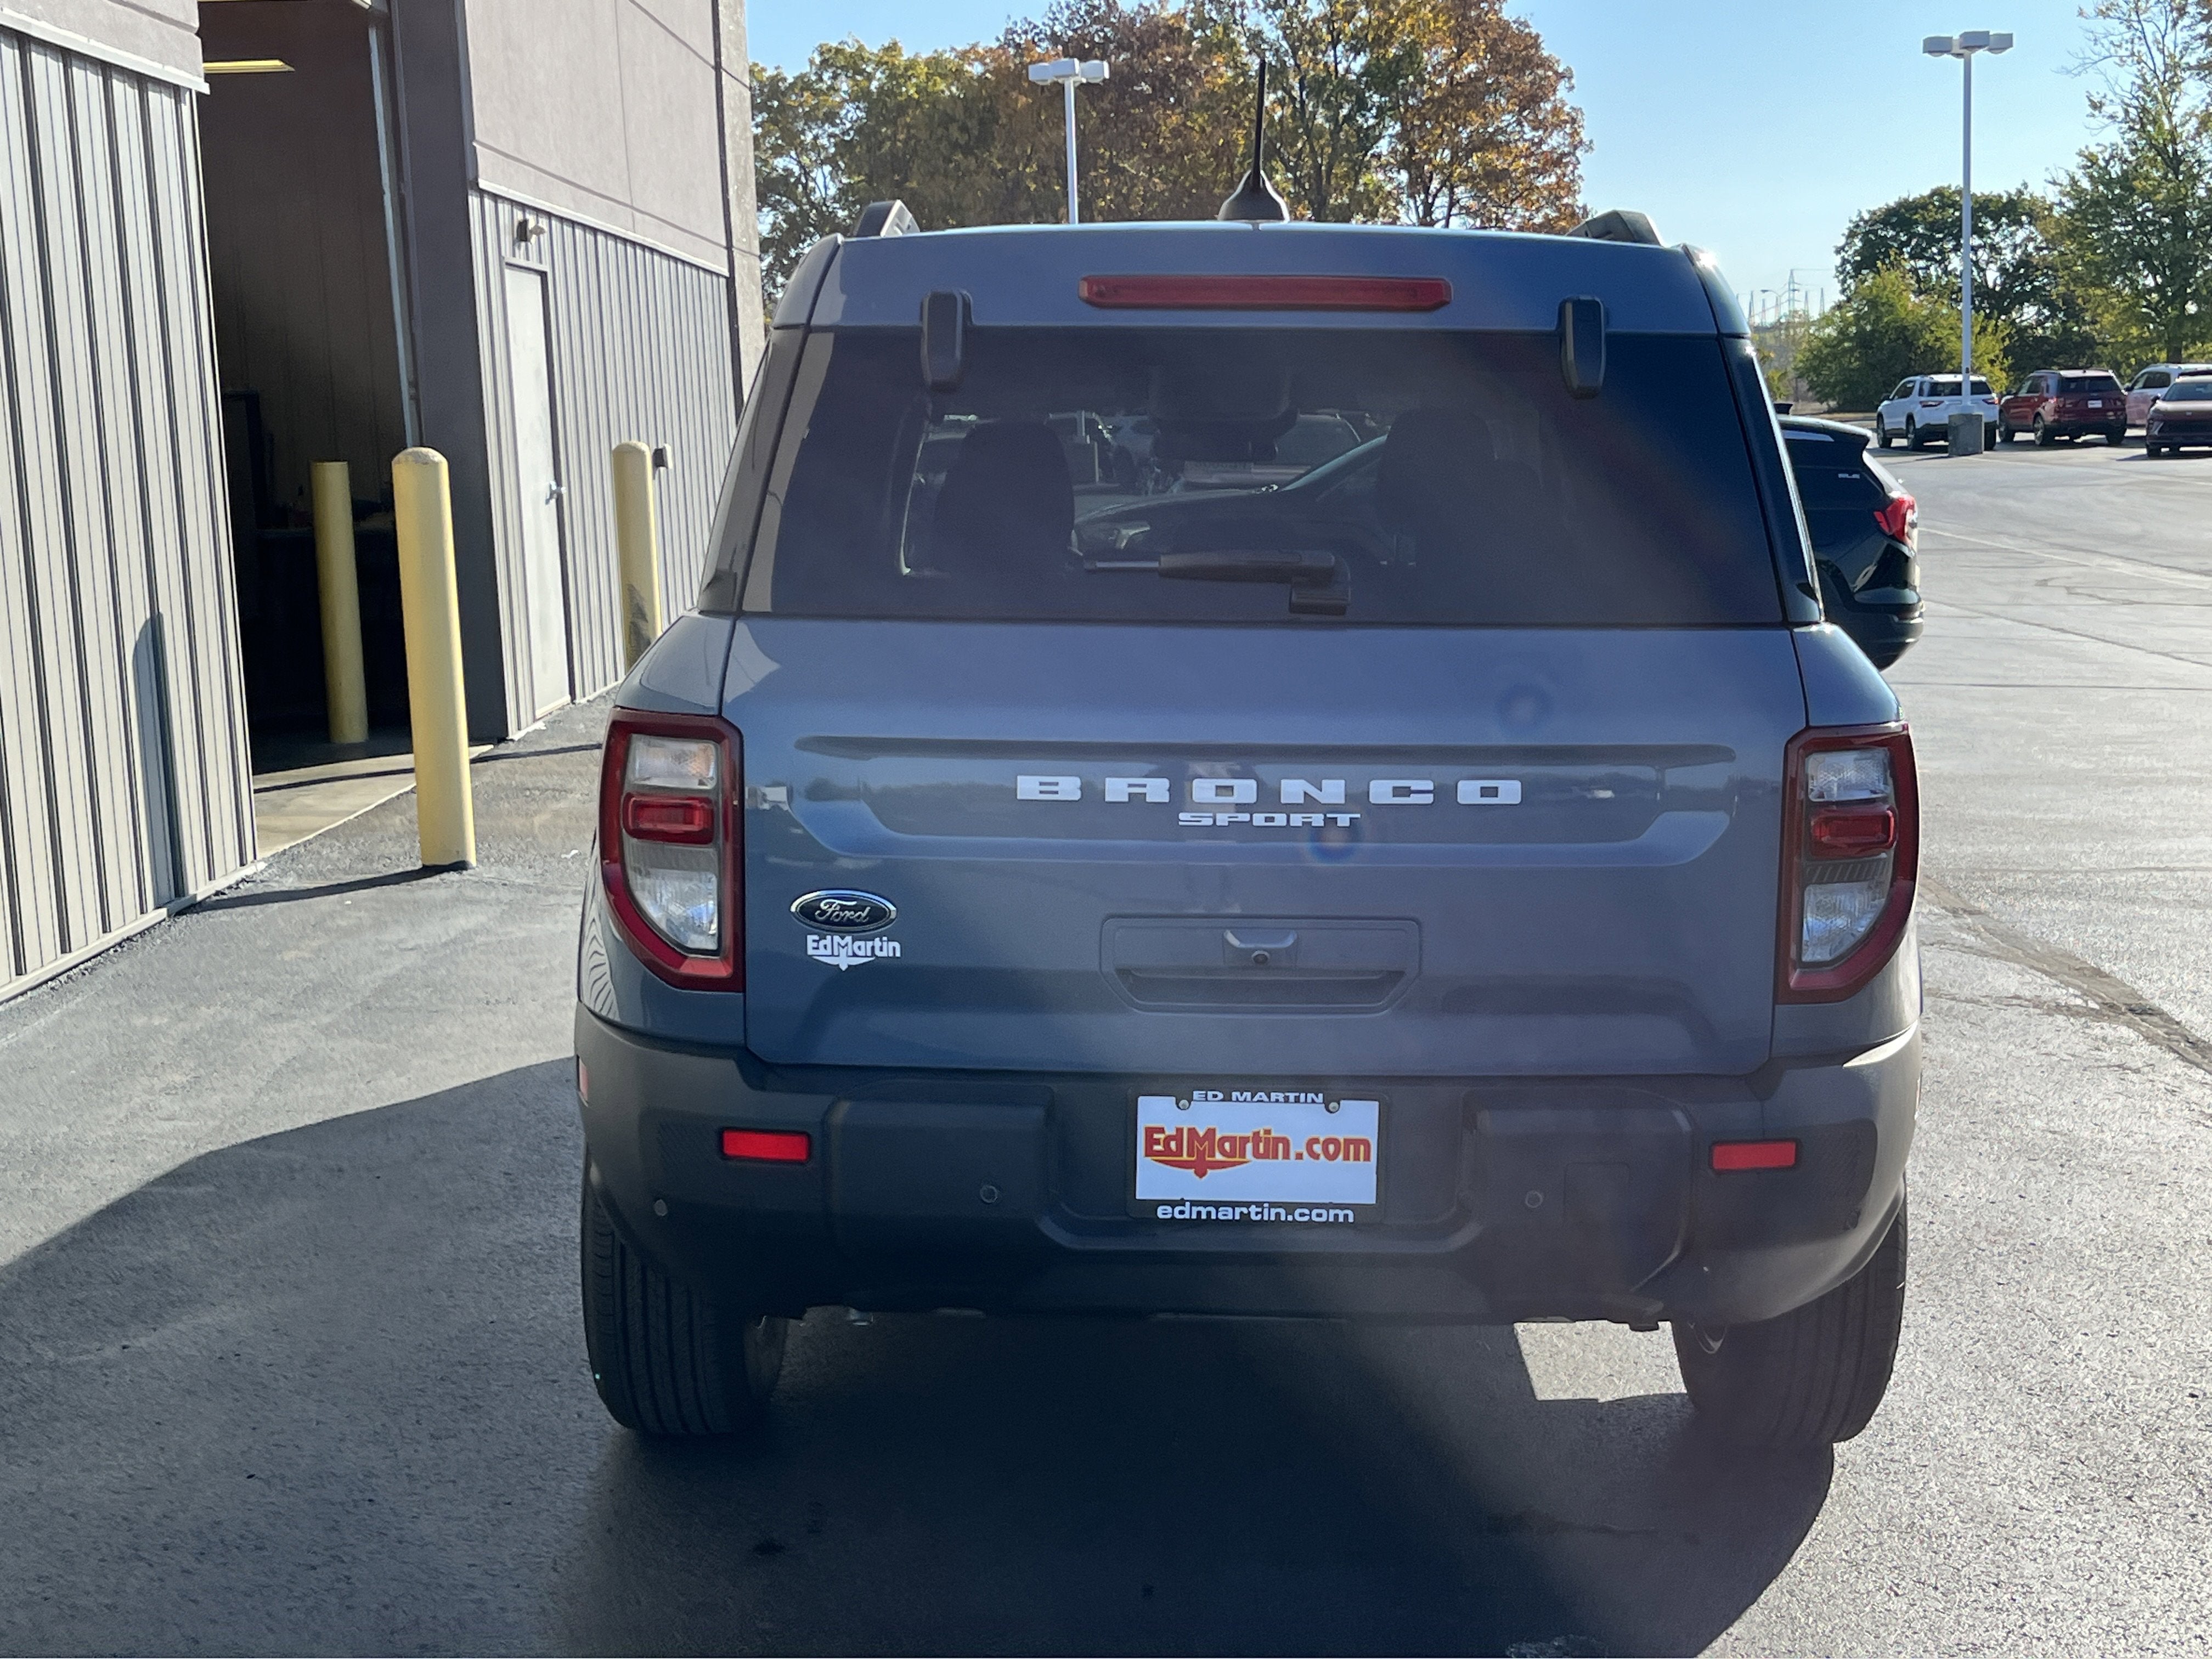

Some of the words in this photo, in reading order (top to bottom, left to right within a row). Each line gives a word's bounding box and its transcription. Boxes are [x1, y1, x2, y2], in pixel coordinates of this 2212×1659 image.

[1016, 775, 1522, 805] BRONCO
[1178, 812, 1361, 827] SPORT
[814, 899, 871, 923] Ford
[806, 934, 901, 957] EdMartin
[1192, 1090, 1224, 1102] ED
[1231, 1091, 1324, 1104] MARTIN
[1143, 1125, 1372, 1163] EdMartin.com
[1156, 1201, 1355, 1223] edmartin.com
